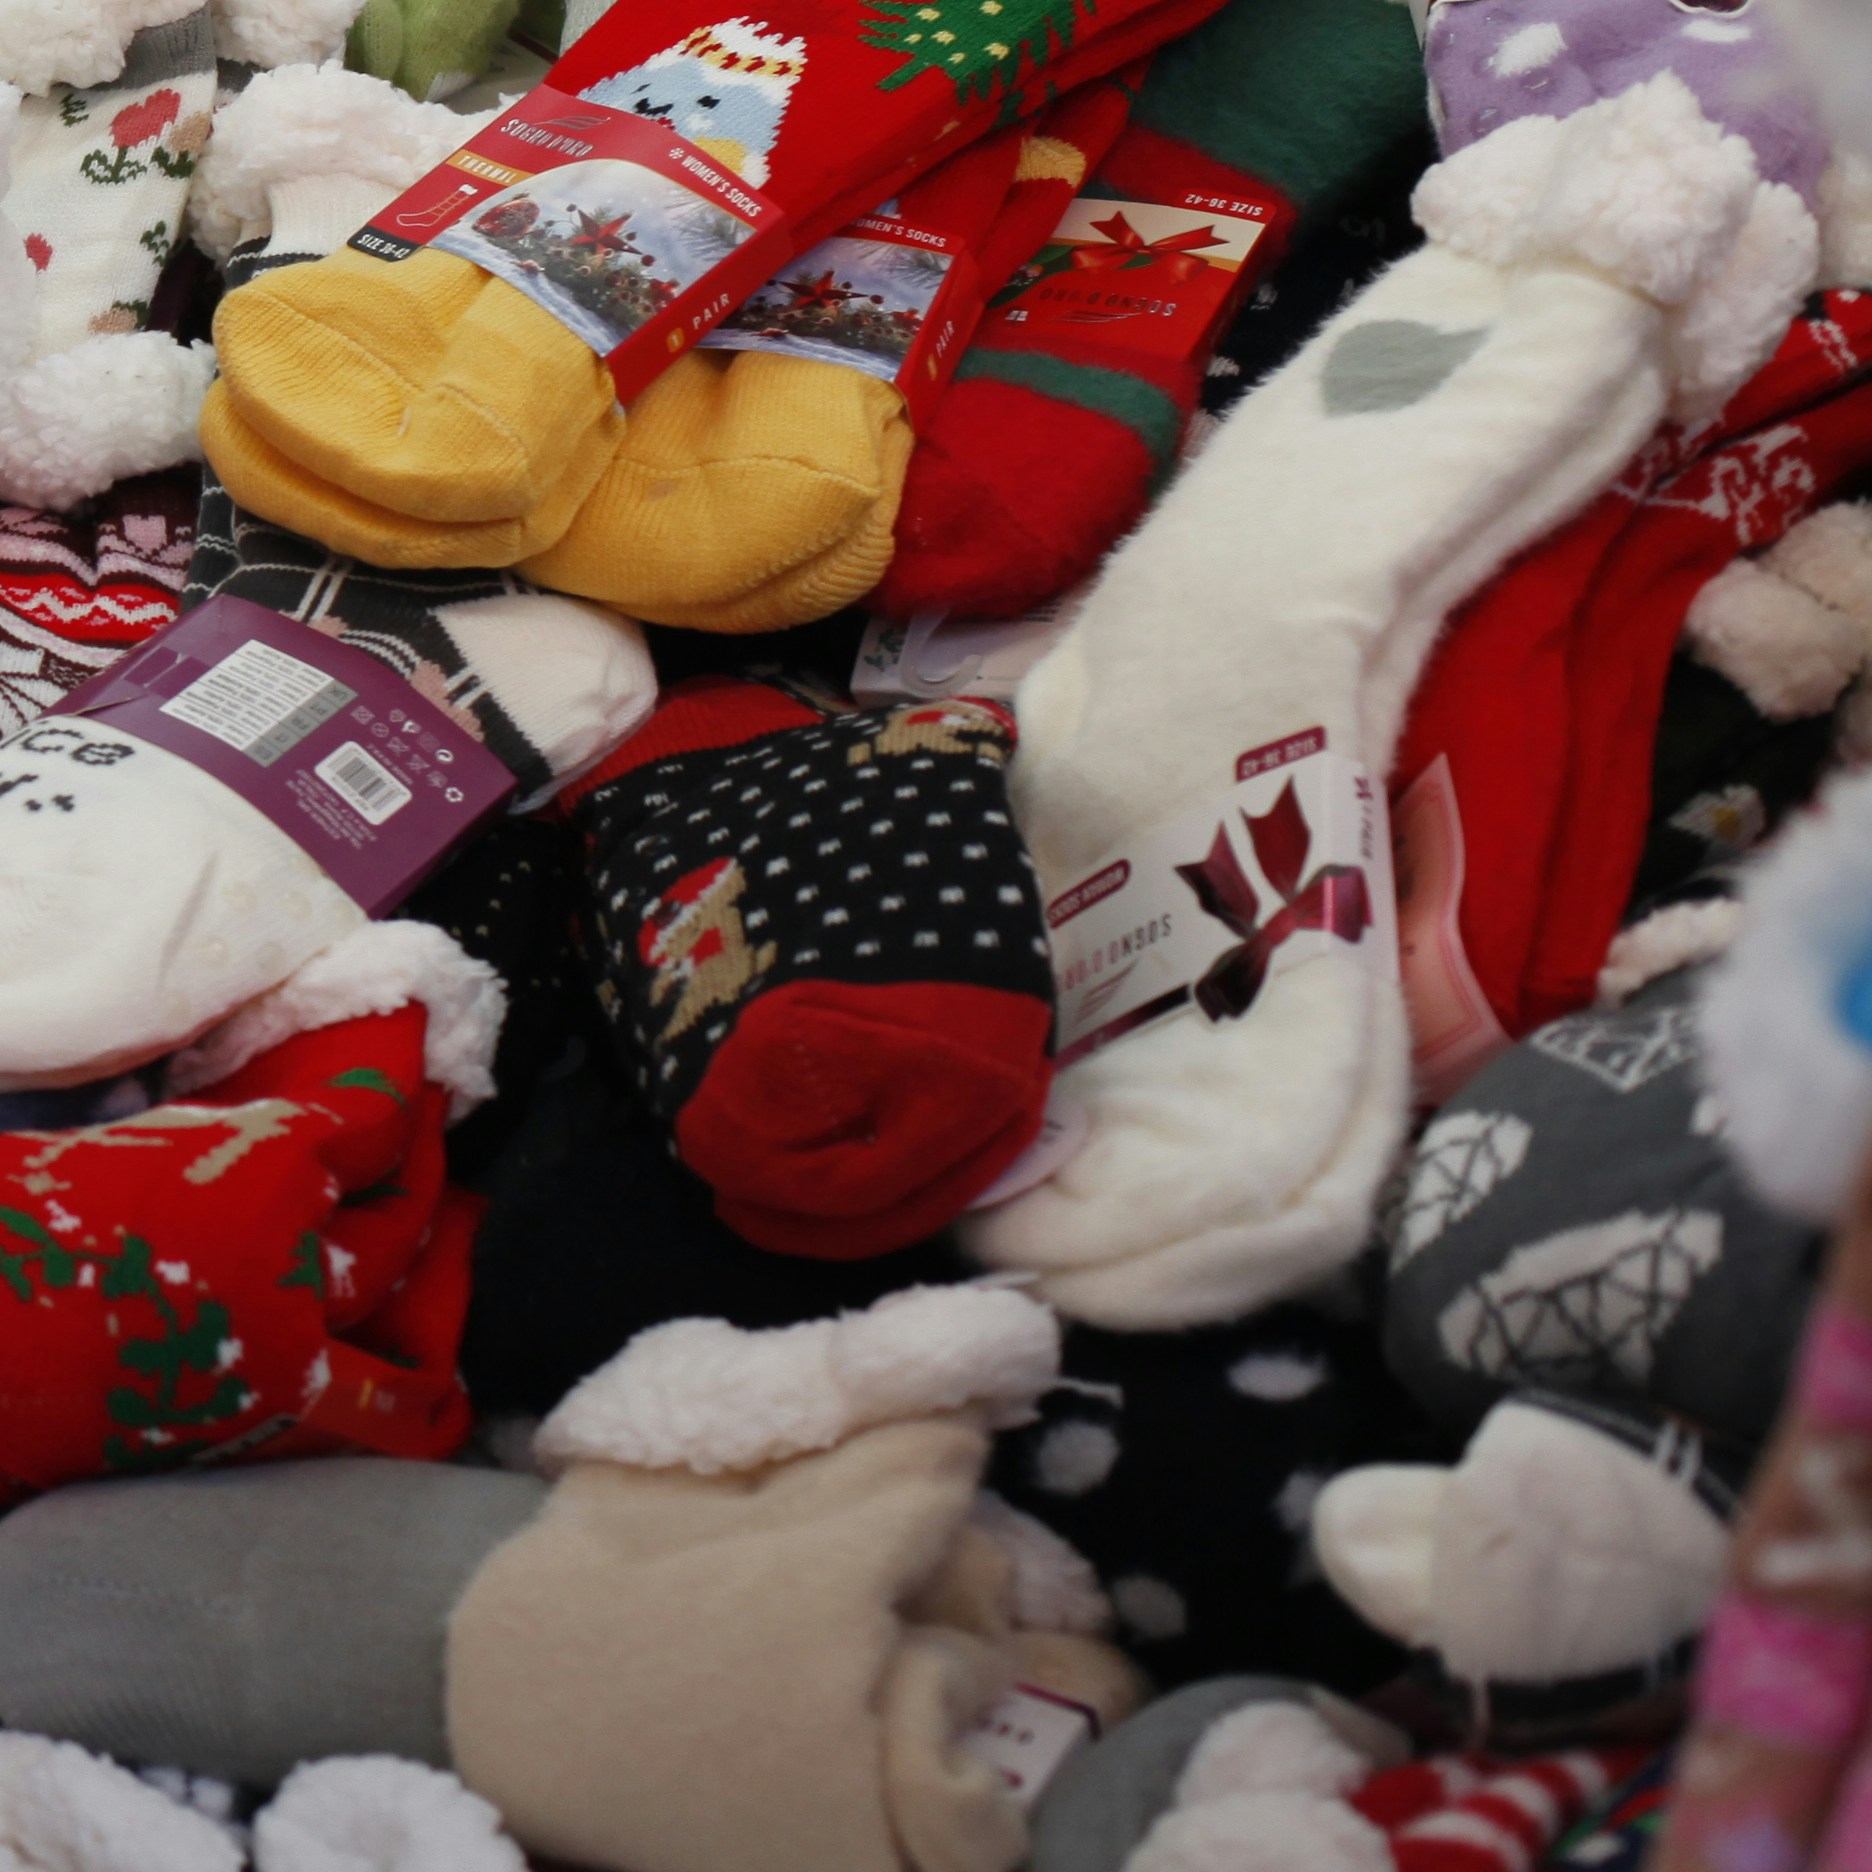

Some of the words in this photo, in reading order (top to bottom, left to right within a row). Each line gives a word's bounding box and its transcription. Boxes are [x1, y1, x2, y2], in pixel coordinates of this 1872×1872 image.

[501, 118, 549, 150] SOGNO
[457, 155, 518, 182] THERMAL
[681, 154, 728, 195] WOMEN'S
[724, 187, 763, 218] SOCKS
[1185, 193, 1226, 210] 36-42
[1230, 200, 1264, 216] SIZE
[356, 232, 383, 248] SIZE
[379, 237, 409, 259] 36-42
[905, 228, 947, 248] SOCKS
[692, 292, 731, 330] PAIR
